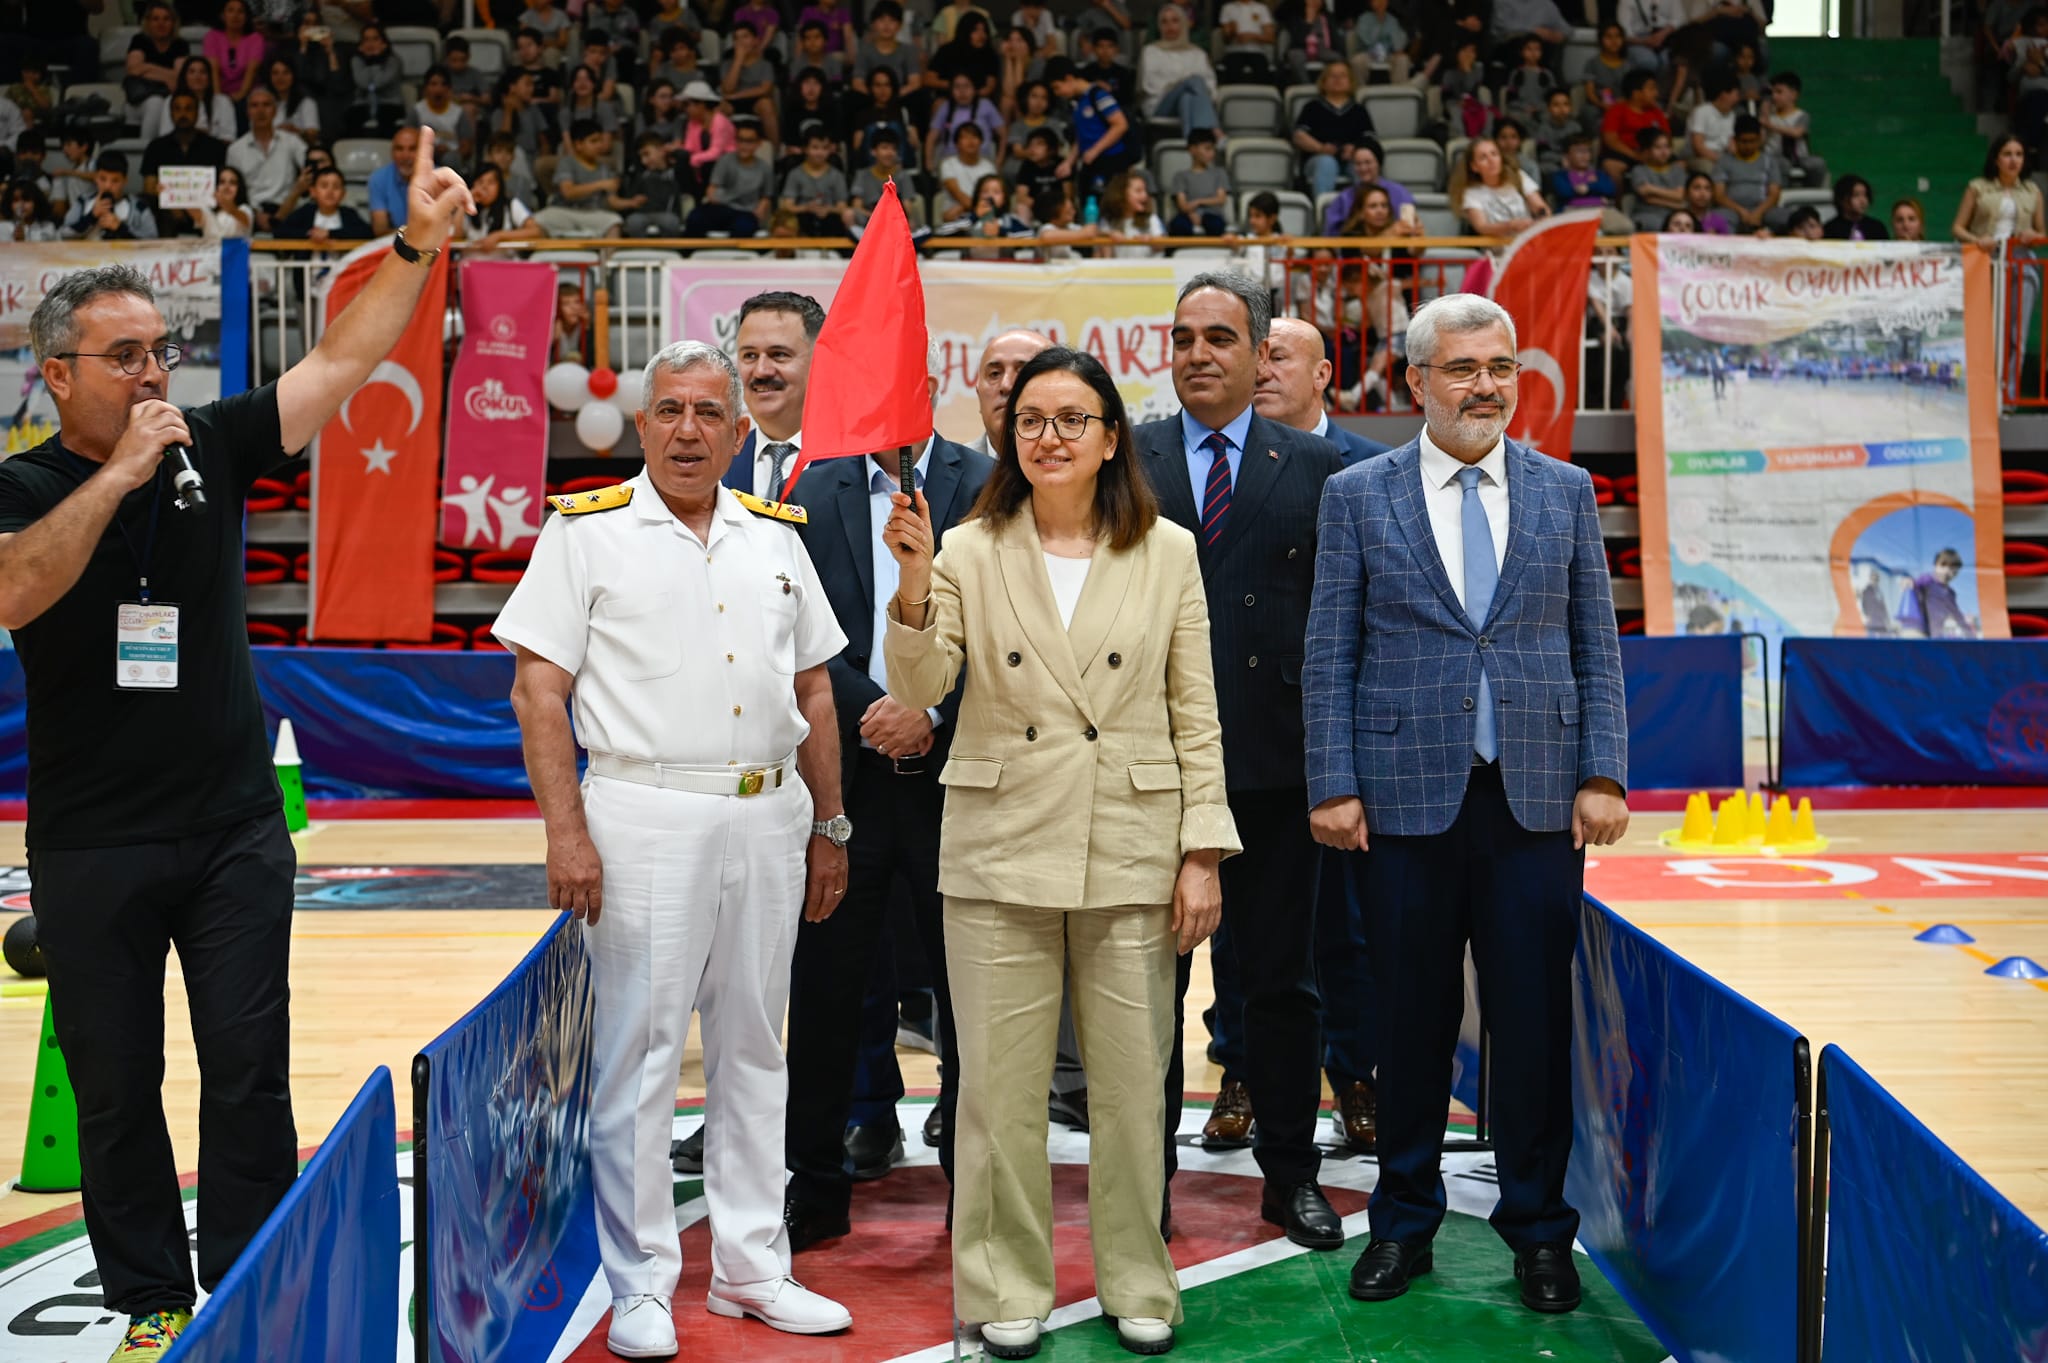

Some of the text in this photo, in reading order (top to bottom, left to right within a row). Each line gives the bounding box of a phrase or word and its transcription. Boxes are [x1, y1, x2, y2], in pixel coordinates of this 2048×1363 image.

[1681, 257, 1949, 319] ÇOCUK OYUNLARI
[1686, 456, 1747, 469] OYUNLAR
[1883, 445, 1942, 460] ÖDÜLLER
